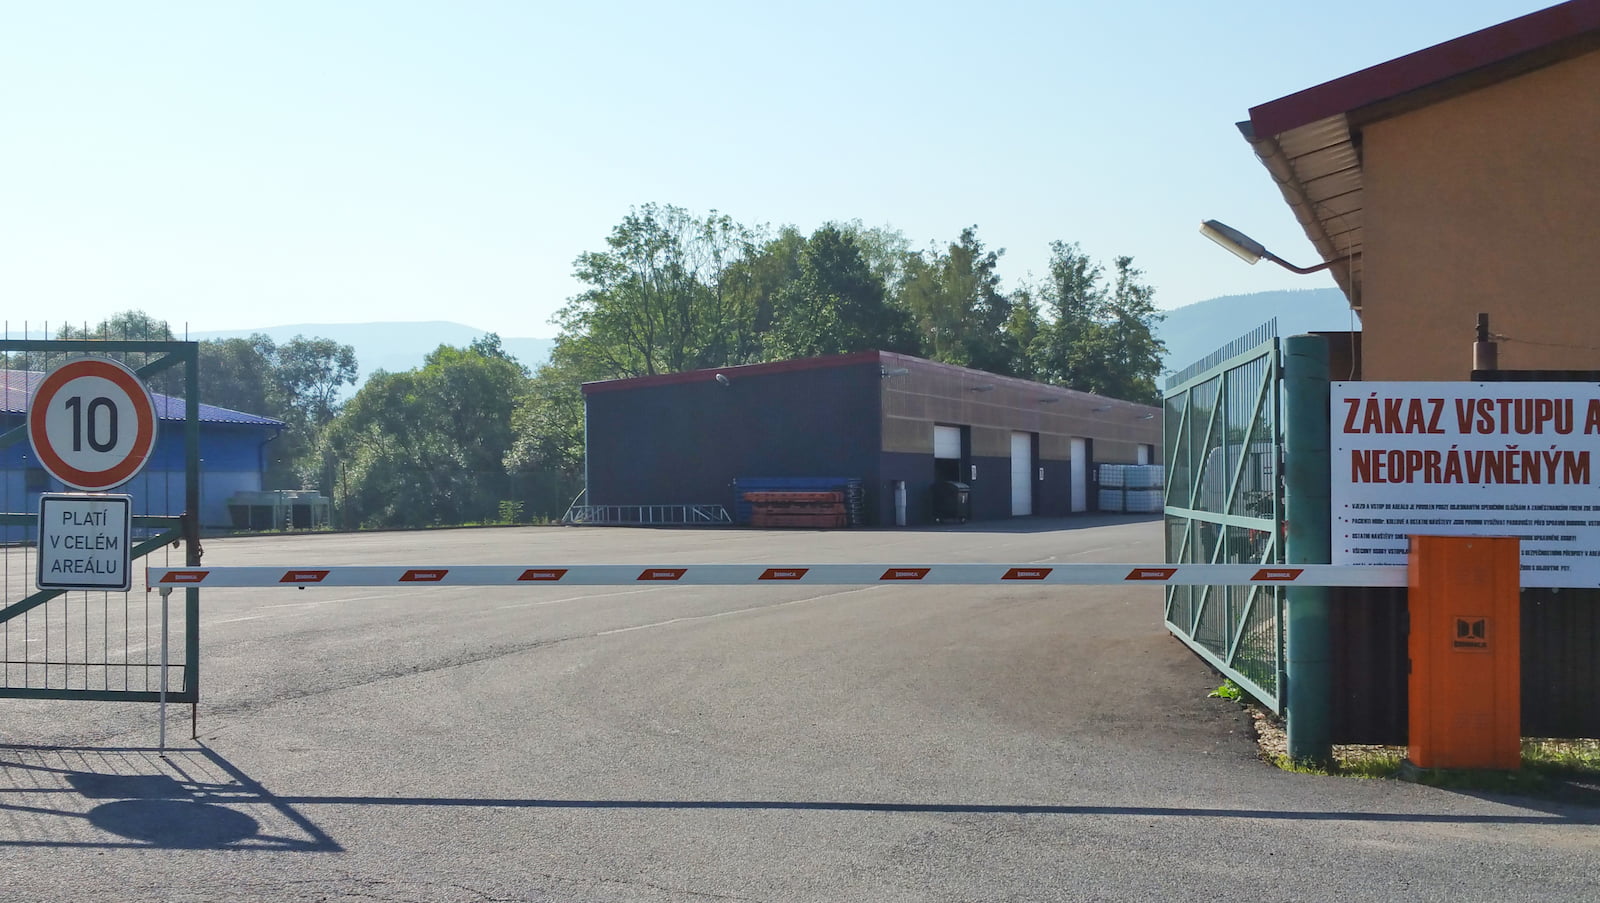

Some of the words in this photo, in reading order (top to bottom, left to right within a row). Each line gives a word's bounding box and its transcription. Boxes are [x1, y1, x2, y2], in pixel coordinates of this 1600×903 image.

[65, 396, 118, 453] 10
[1343, 392, 1445, 434] ZÁKAZ
[1455, 398, 1573, 435] VSTUPU
[1584, 398, 1600, 435] A
[1351, 444, 1590, 485] NEOPRÁVNĚNÝM
[62, 509, 108, 526] PLATÍ
[50, 535, 60, 550] V
[64, 532, 118, 550] CELÉM
[51, 556, 117, 574] AREÁLU
